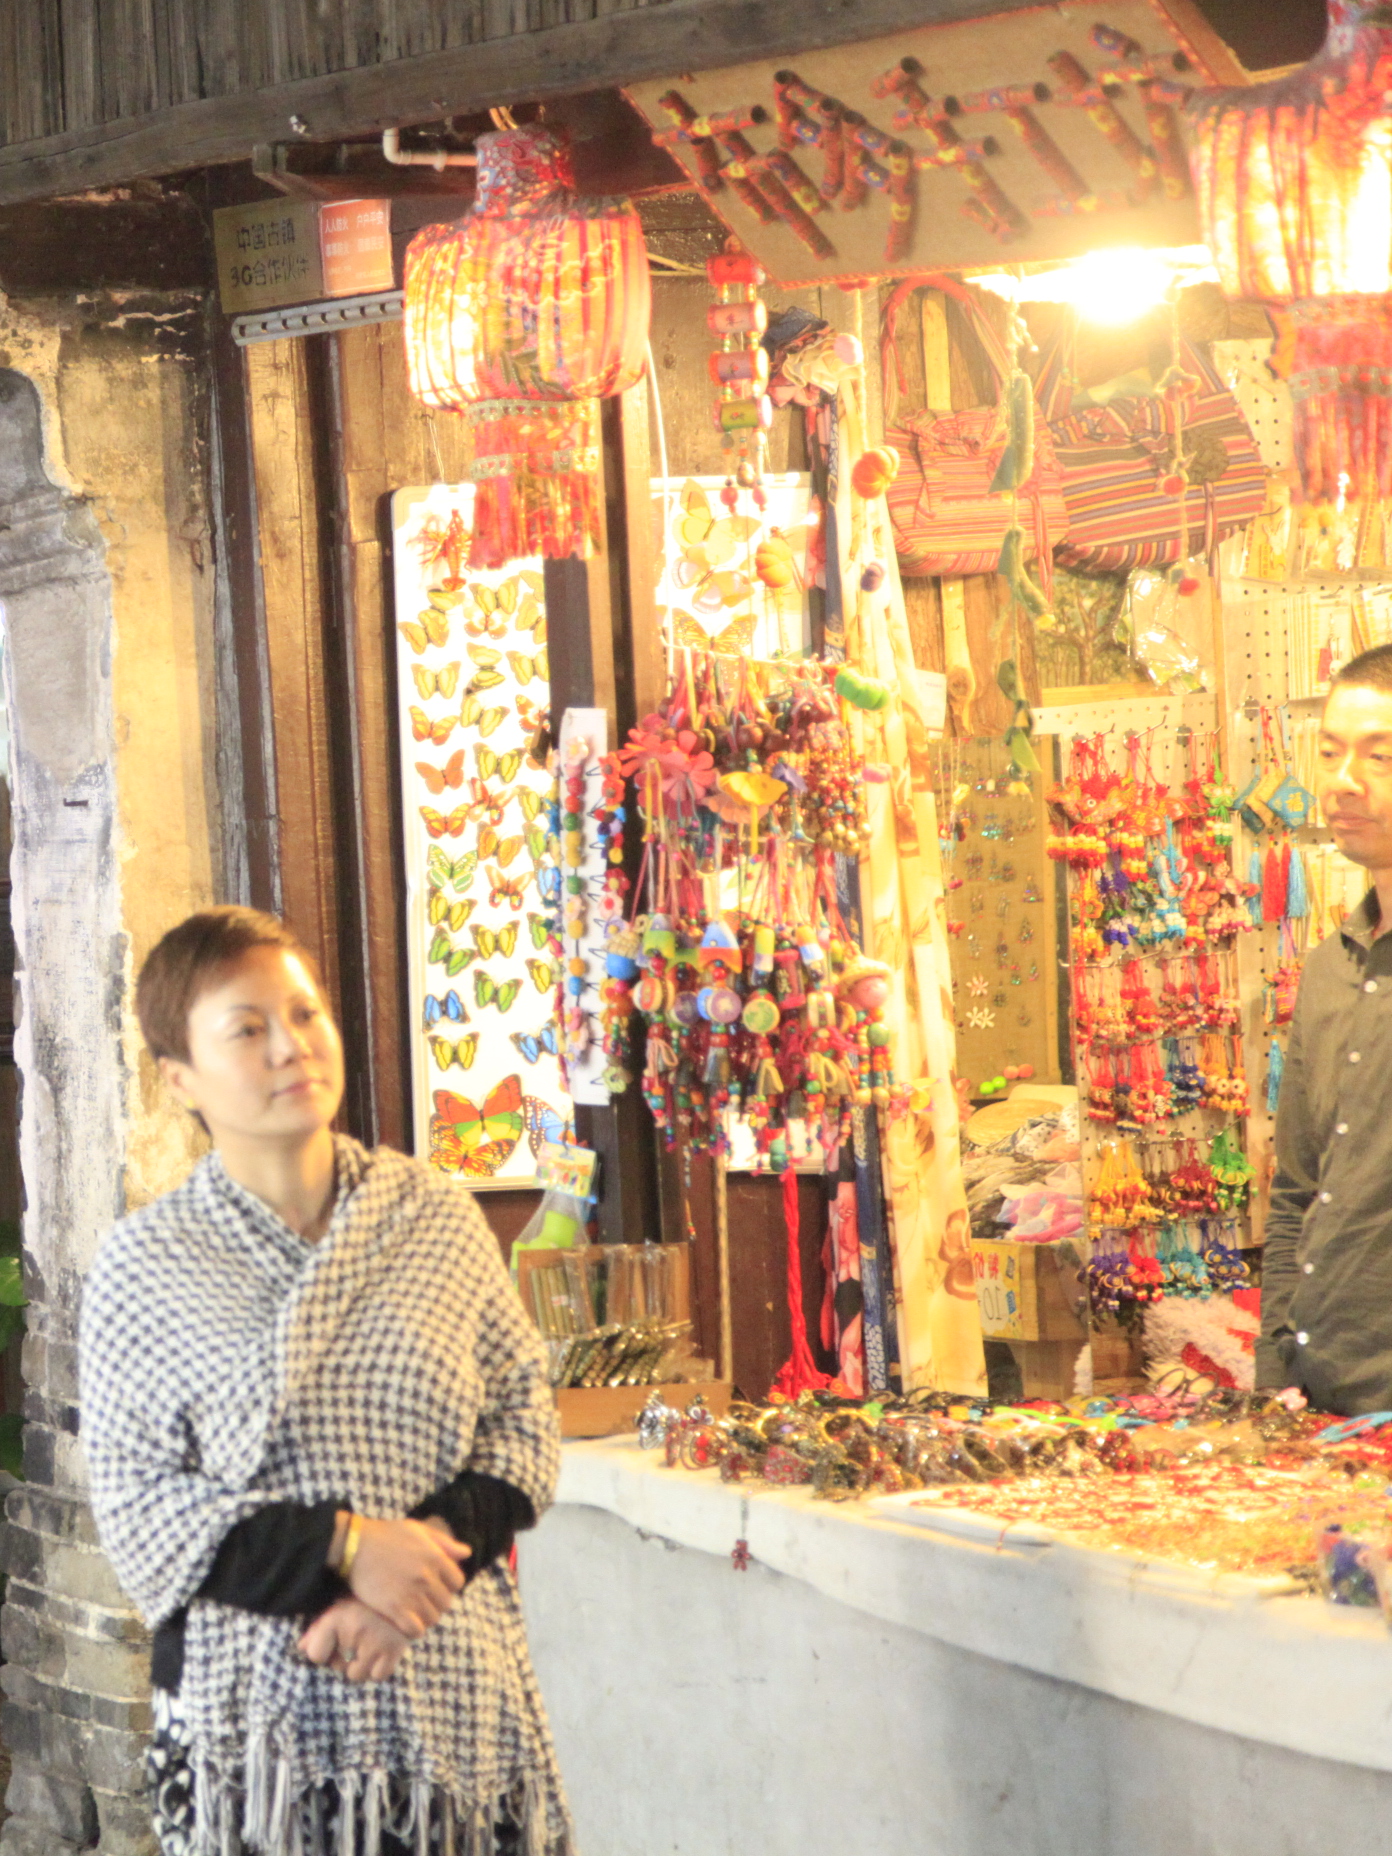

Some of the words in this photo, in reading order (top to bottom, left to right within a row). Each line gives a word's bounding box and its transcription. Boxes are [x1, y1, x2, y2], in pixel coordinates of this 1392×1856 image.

[236, 217, 296, 252] 中国古镇
[230, 256, 309, 288] 3G合作伙伴
